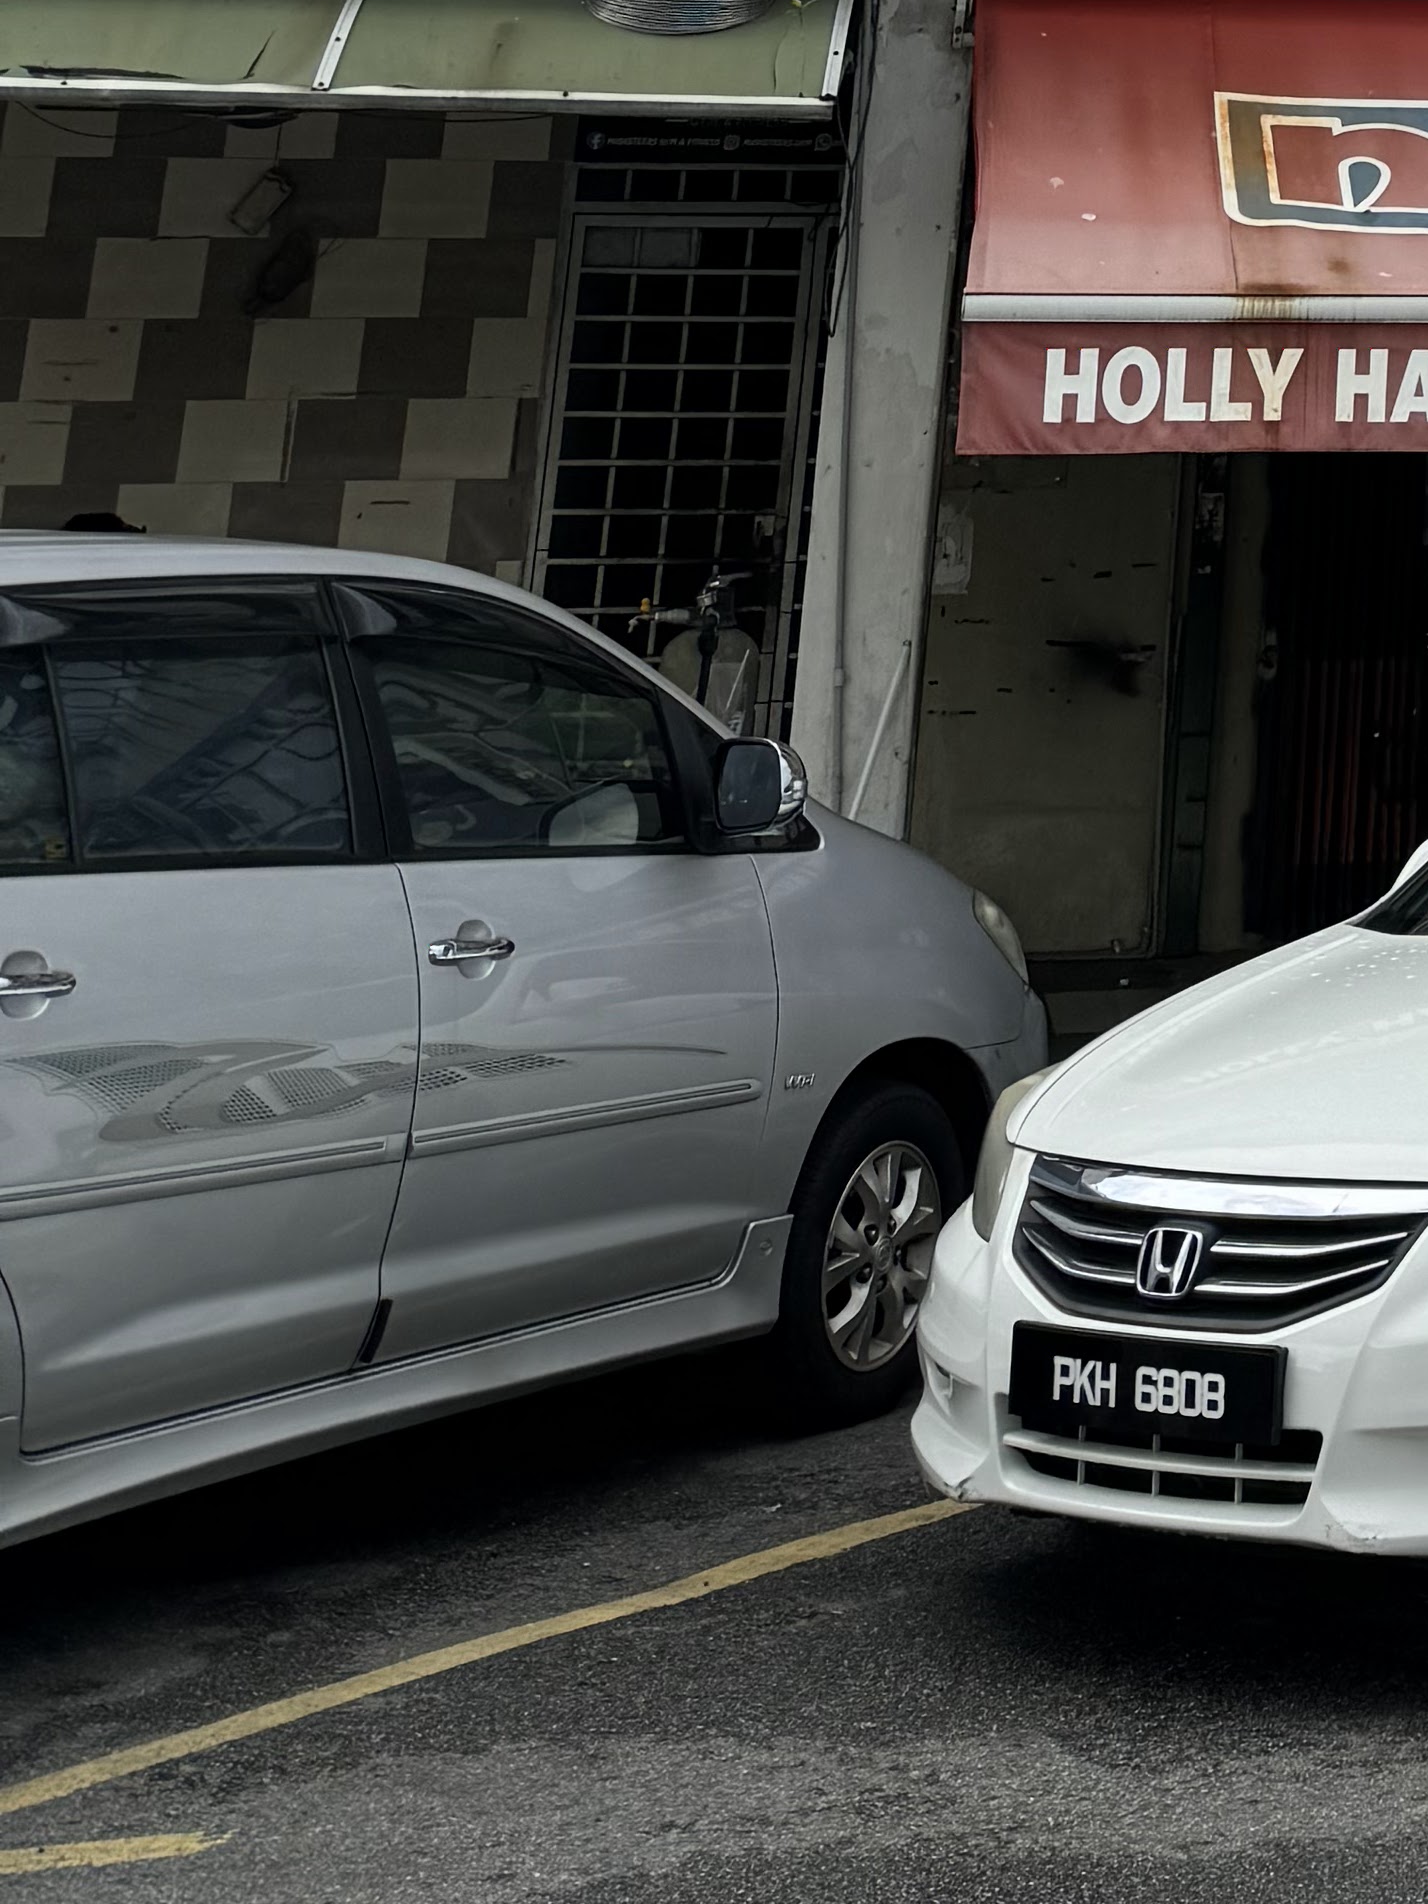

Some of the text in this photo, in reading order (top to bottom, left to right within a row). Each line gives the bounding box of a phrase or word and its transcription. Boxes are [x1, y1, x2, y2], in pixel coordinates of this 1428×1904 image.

[1041, 345, 1303, 425] HOLLY
[1053, 1355, 1225, 1419] PKH 6808
